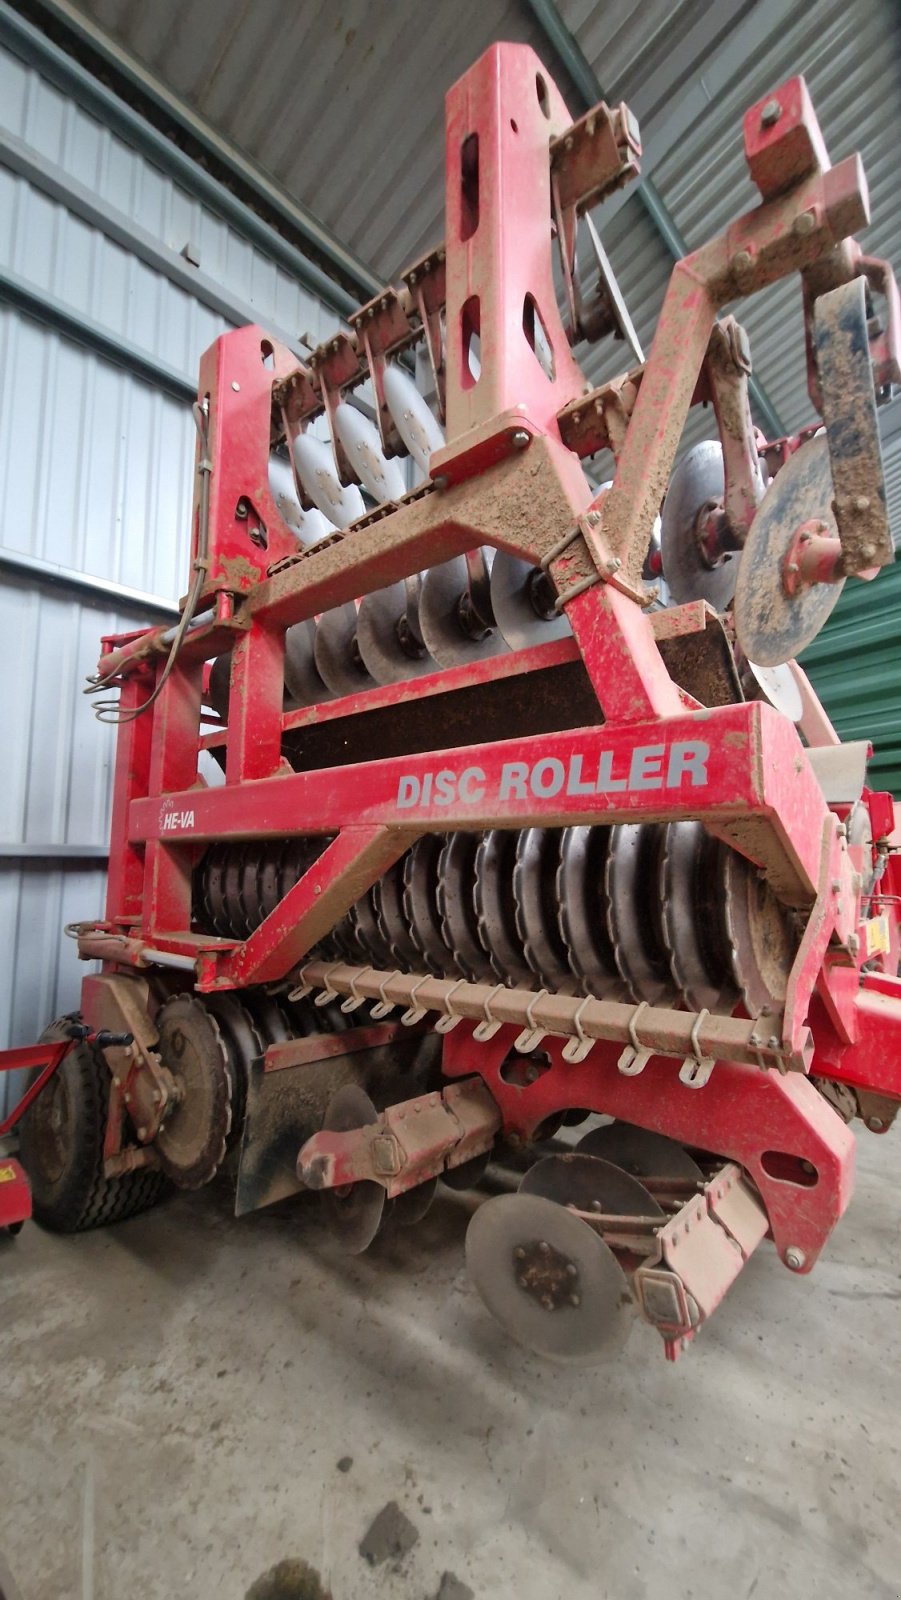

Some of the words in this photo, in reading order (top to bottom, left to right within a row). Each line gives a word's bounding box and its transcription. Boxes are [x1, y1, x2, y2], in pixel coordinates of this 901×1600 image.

[396, 767, 486, 809] DISC
[498, 740, 710, 799] ROLLER
[163, 810, 195, 830] HE-VA
